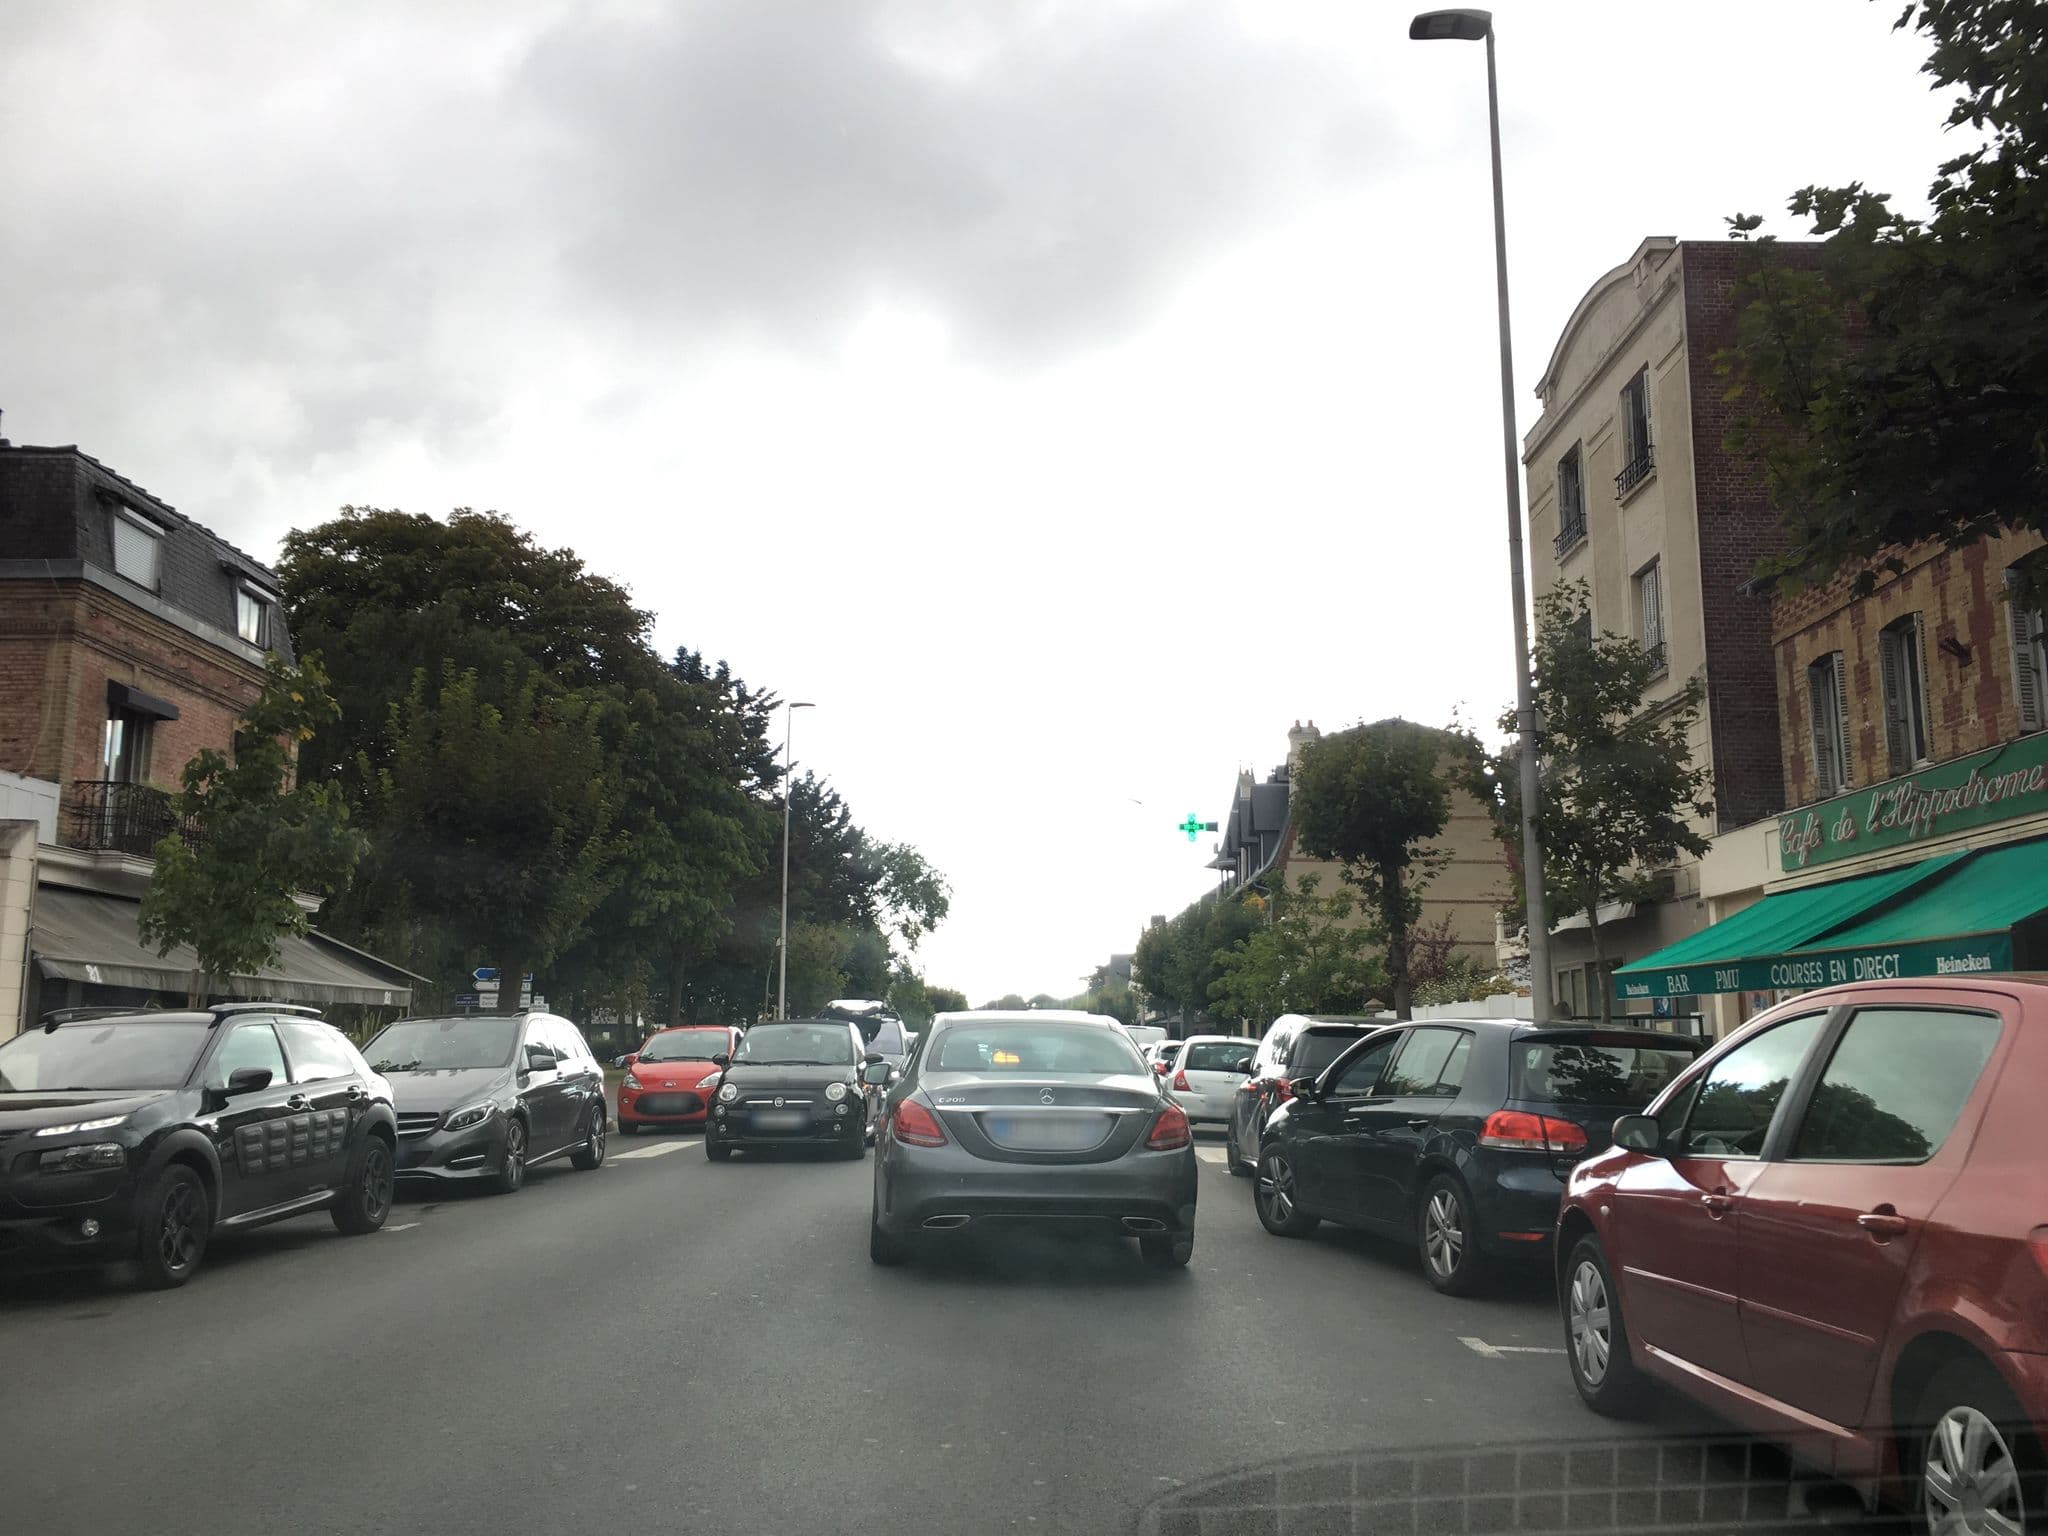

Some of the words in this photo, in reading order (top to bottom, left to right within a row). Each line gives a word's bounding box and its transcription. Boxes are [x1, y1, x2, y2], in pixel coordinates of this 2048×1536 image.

[1779, 812, 1821, 865] Café
[1831, 807, 1855, 842] de
[1865, 764, 2048, 839] l'Hippodrome
[1770, 961, 1824, 985] COURSES
[1829, 959, 1847, 982] EN
[1853, 953, 1900, 980] DIRECT
[1936, 954, 1992, 974] Heineken
[1666, 974, 1690, 993] BAR
[1714, 968, 1740, 990] PMU
